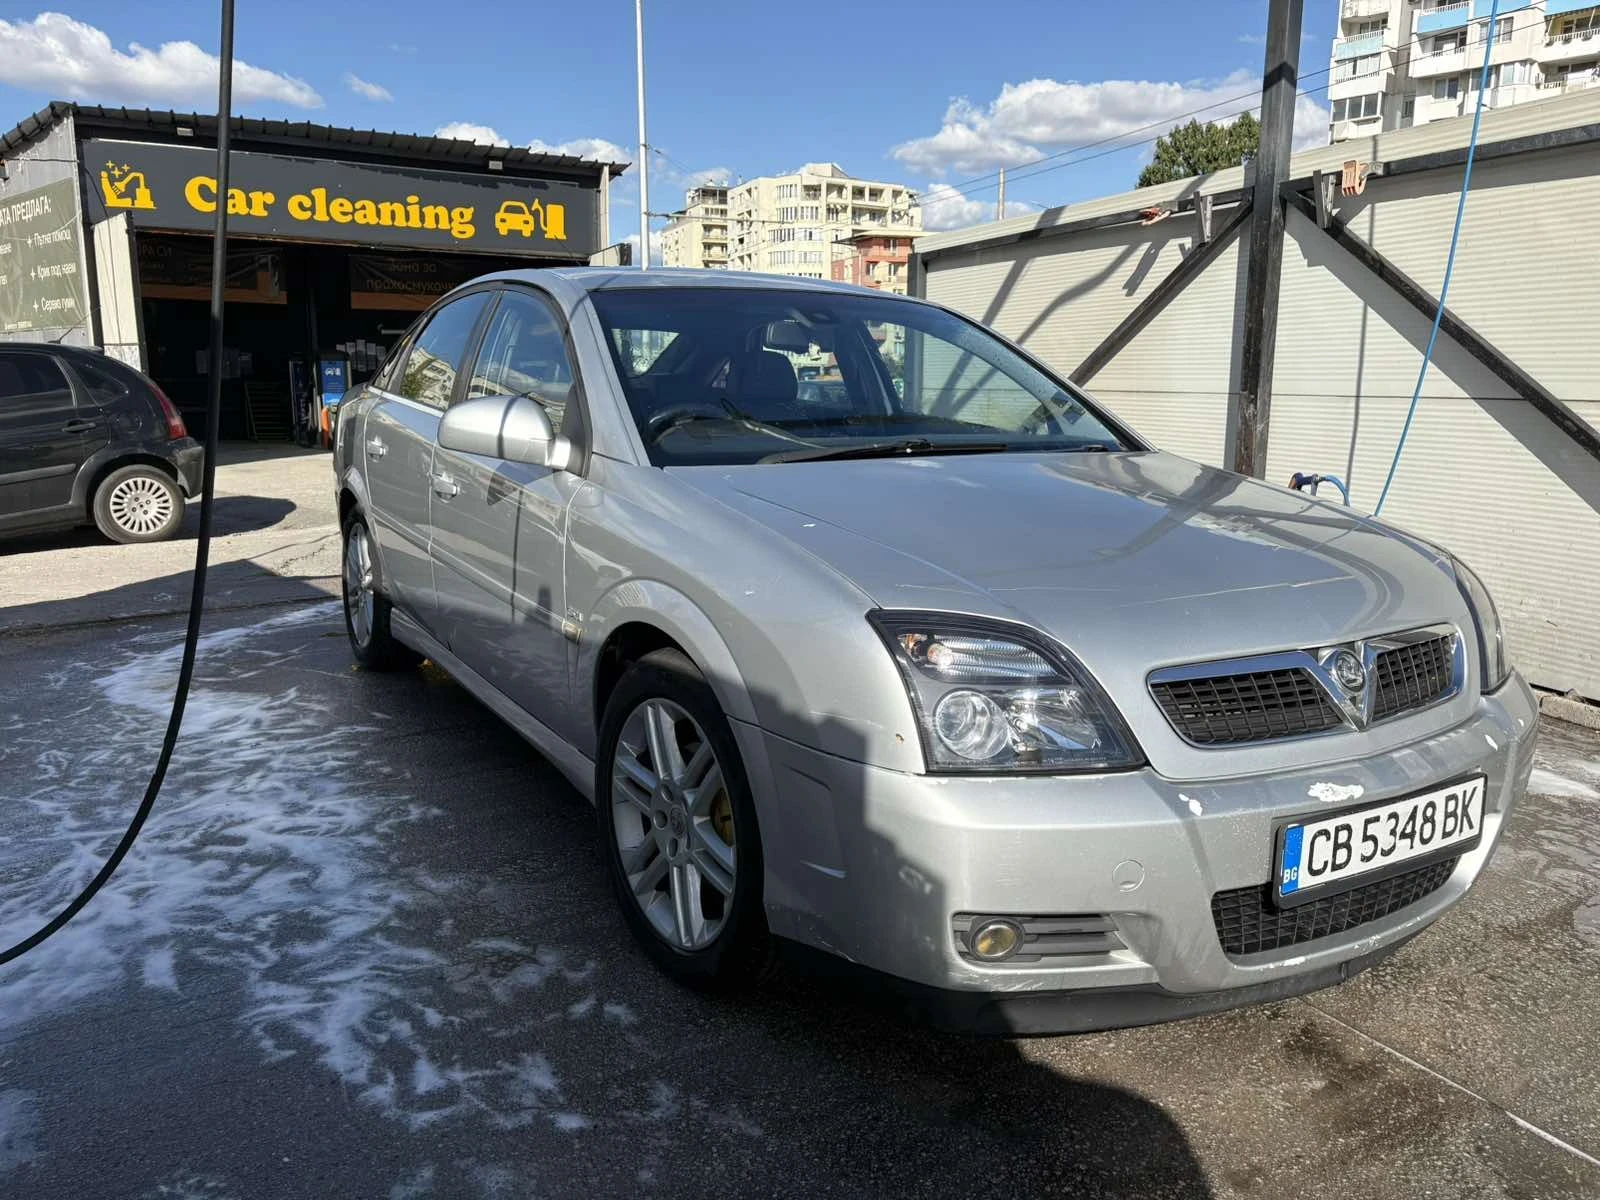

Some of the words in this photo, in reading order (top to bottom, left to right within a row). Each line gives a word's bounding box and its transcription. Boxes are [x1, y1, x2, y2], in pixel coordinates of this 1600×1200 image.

[11, 195, 52, 223] ПРЕДЛАГА:
[185, 176, 275, 217] Car
[287, 188, 476, 239] cleaning
[1307, 823, 1353, 877] CB
[1361, 800, 1437, 863] 5348
[1441, 786, 1479, 842] BK
[1284, 866, 1298, 882] BG
